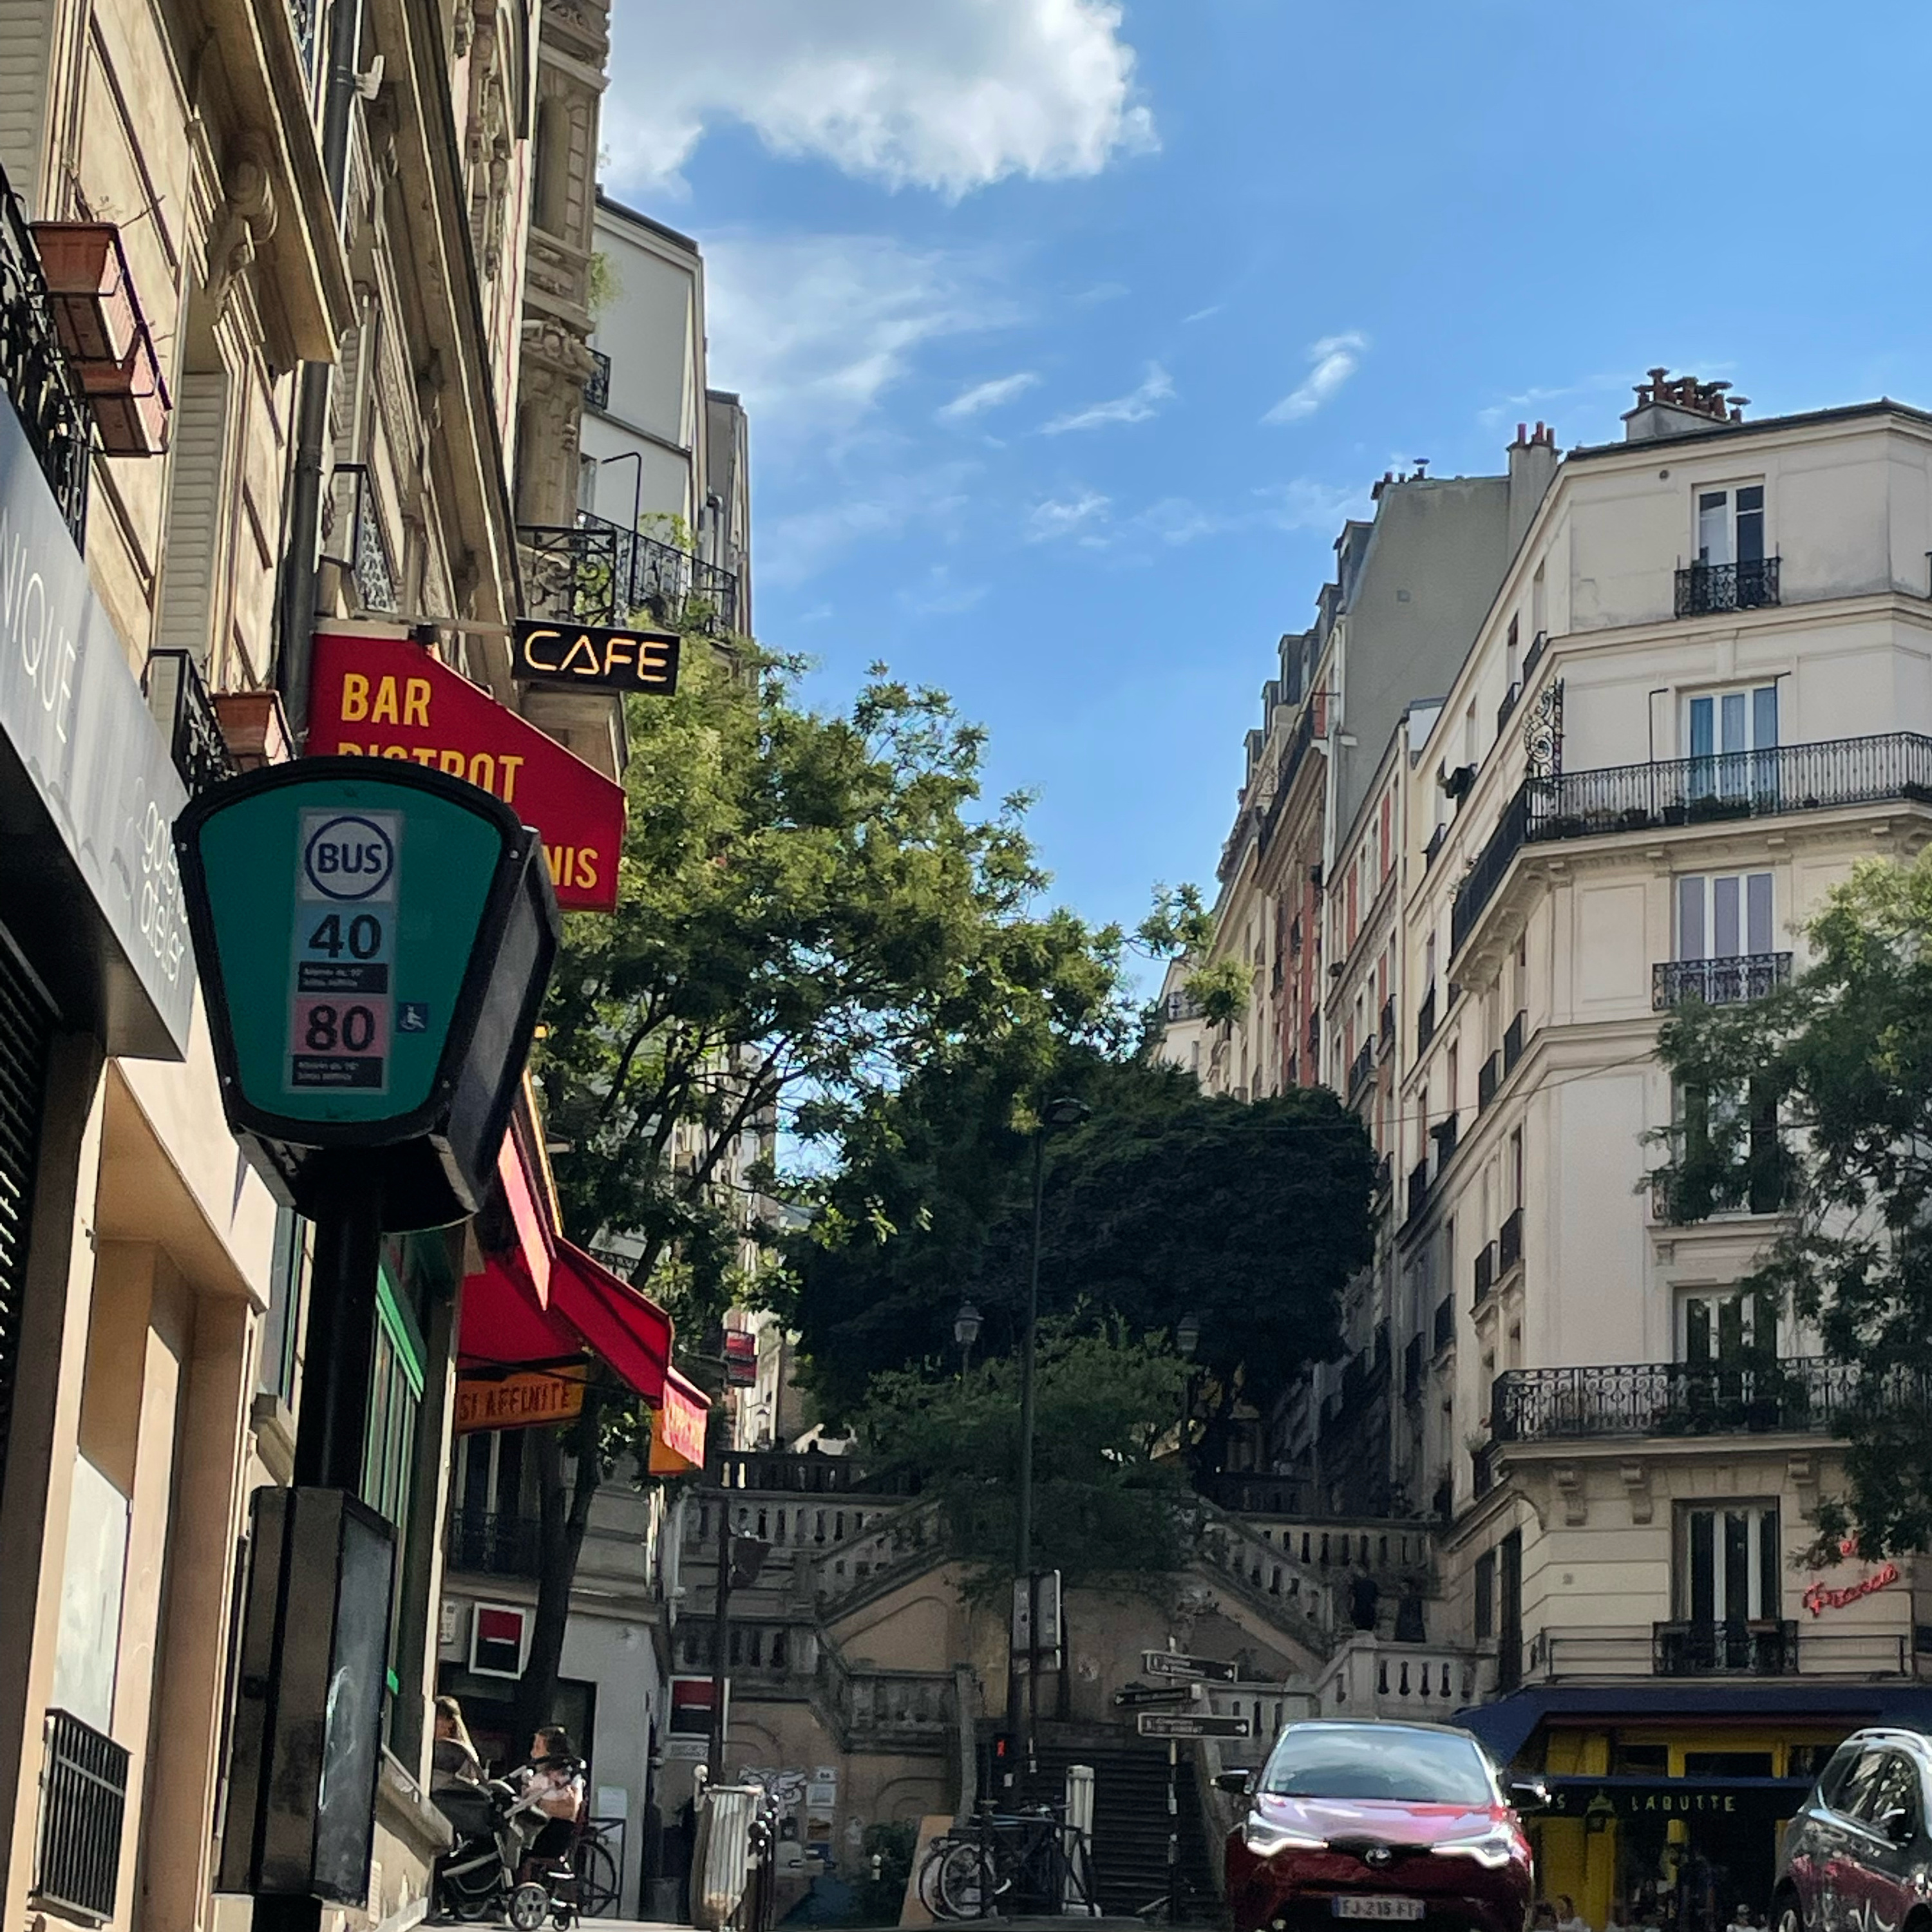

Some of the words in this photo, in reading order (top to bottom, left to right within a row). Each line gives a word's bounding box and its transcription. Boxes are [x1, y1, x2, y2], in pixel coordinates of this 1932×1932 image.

[524, 629, 670, 683] CAFE
[341, 672, 431, 727] BAR
[317, 843, 383, 874] BUS
[308, 914, 383, 960] 40
[305, 1005, 375, 1052] 80
